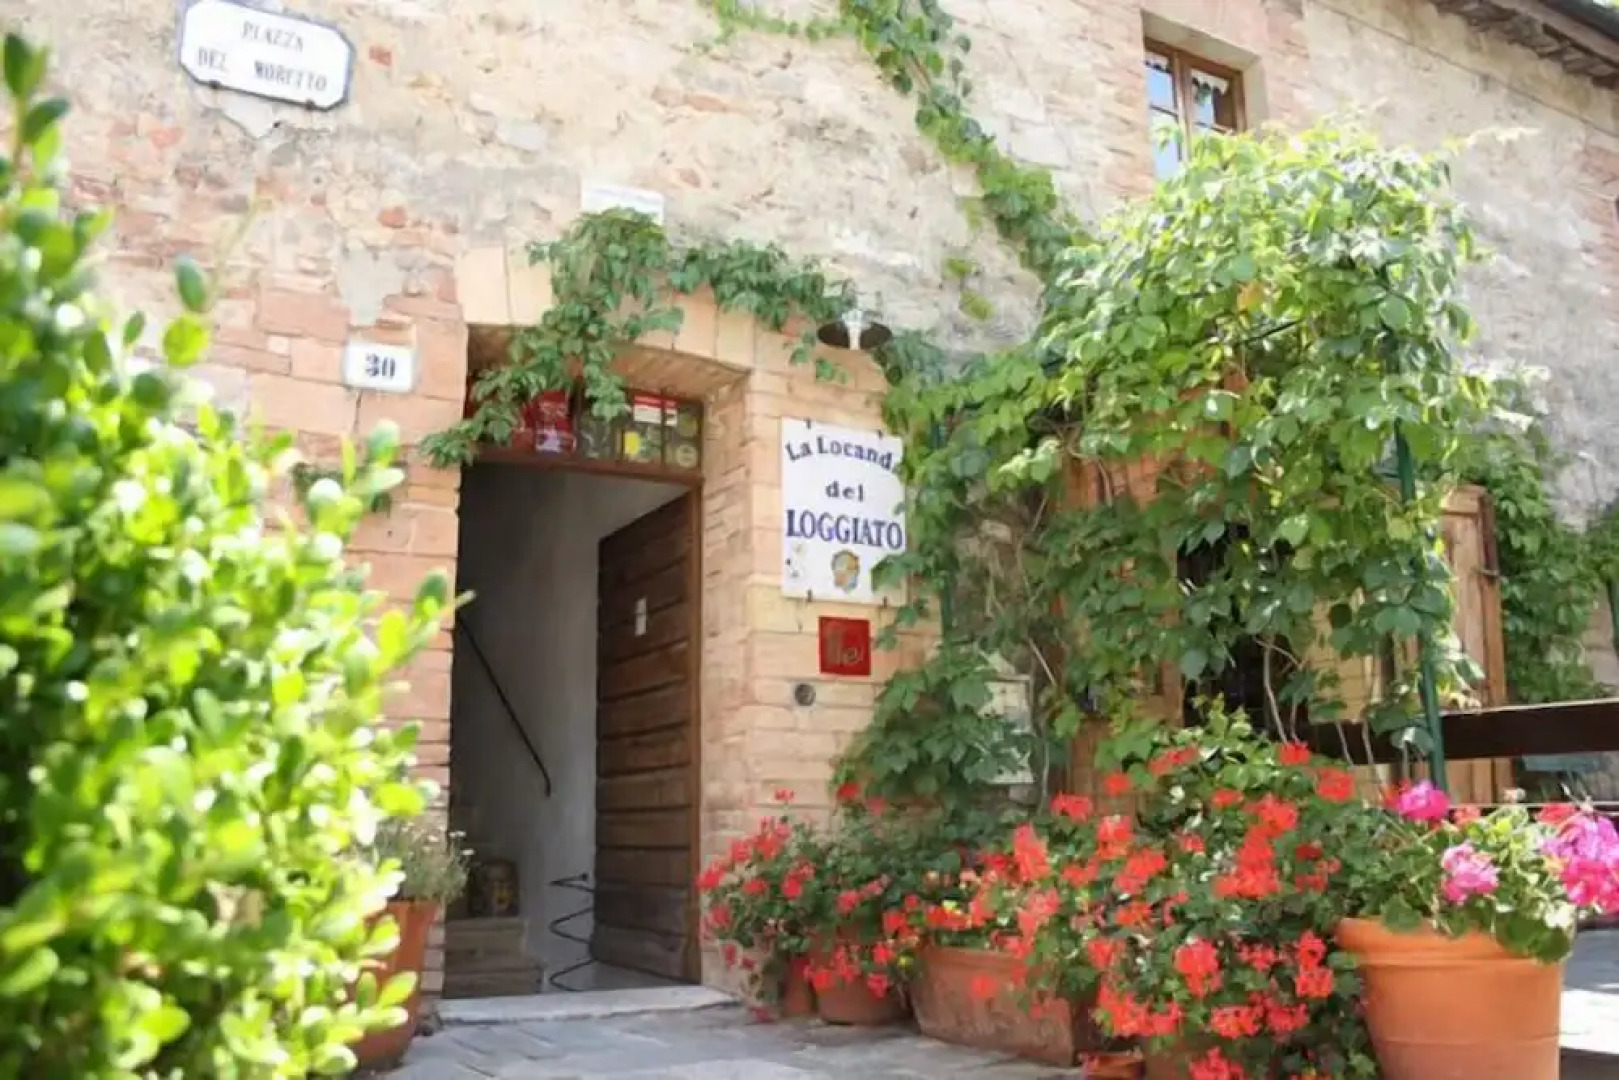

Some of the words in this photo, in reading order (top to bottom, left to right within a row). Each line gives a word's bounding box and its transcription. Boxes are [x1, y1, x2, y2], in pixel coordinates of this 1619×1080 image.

[242, 21, 304, 52] PIAZZA
[198, 47, 228, 71] DEL
[254, 60, 327, 91] MORETTO
[365, 353, 396, 378] 30
[785, 440, 812, 462] La
[817, 436, 899, 474] Locand
[826, 481, 865, 502] del
[786, 510, 903, 550] LOGGIATO
